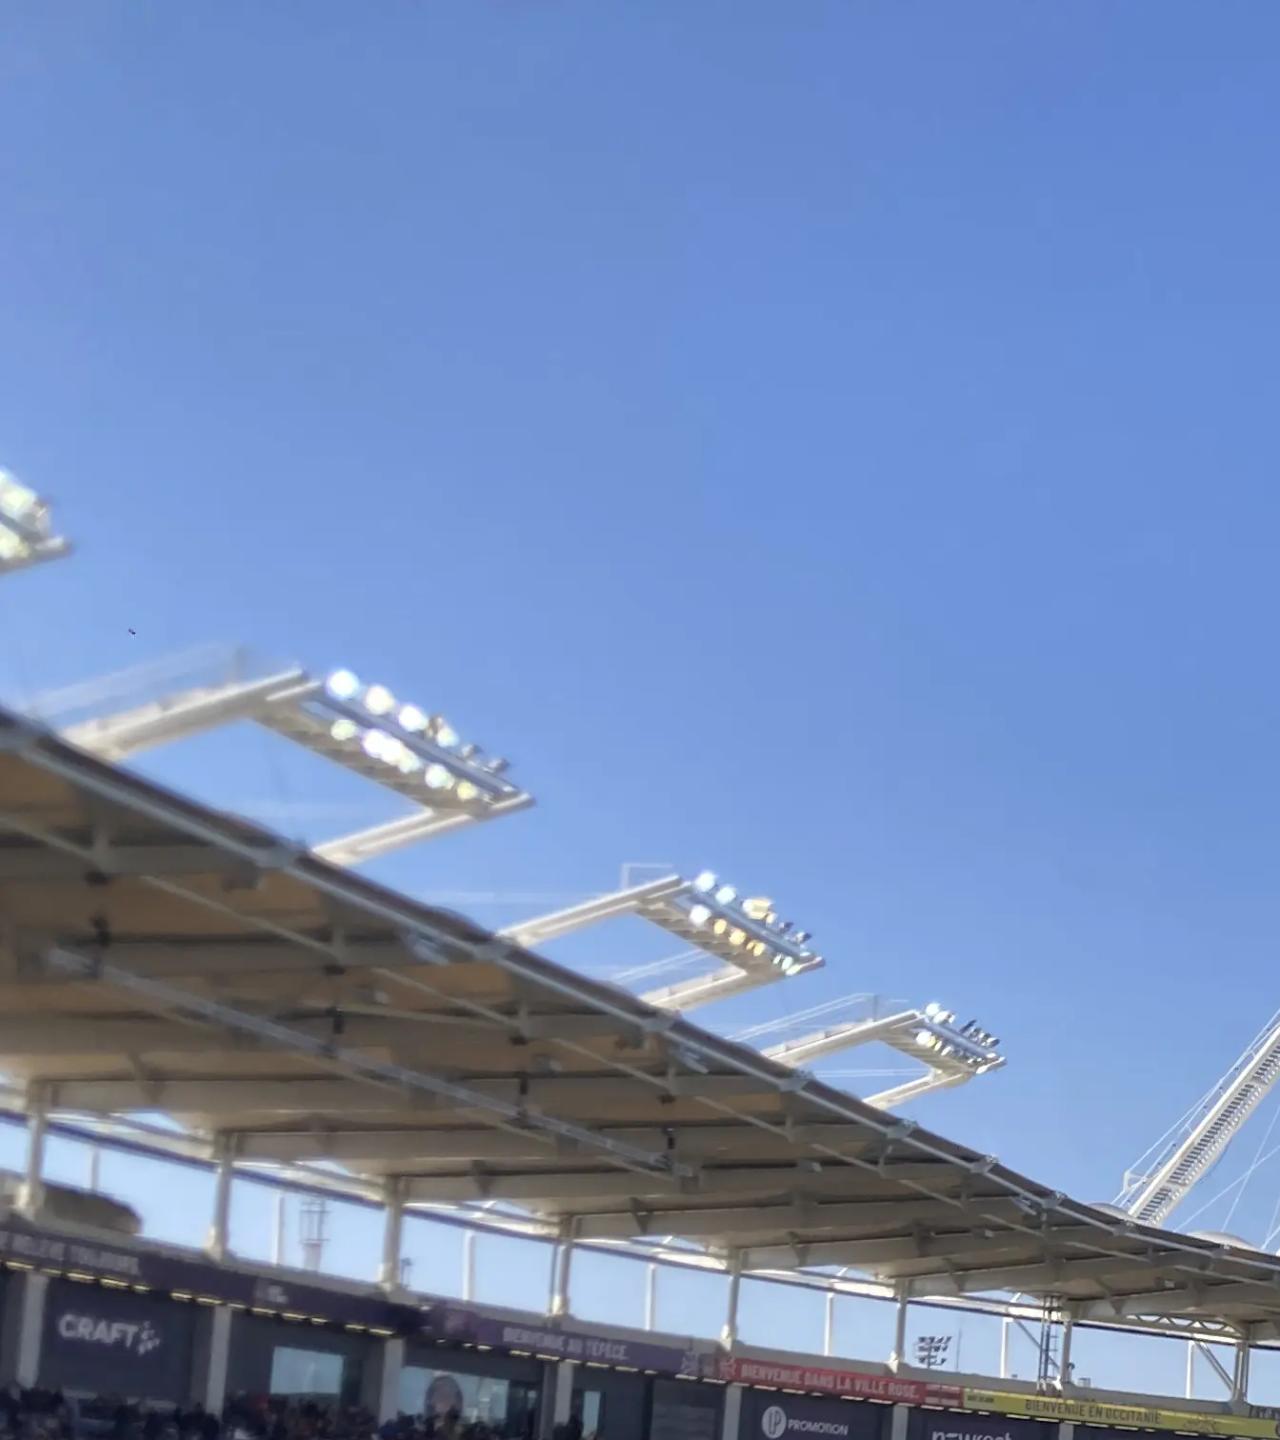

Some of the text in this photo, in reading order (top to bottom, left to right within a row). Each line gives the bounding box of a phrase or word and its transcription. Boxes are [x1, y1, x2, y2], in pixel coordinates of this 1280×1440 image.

[58, 1313, 141, 1348] CRAFT
[740, 1363, 802, 1385] BIENVENUE
[804, 1371, 835, 1390] DANS
[836, 1373, 851, 1390] LA
[854, 1377, 885, 1395] VILLE
[1025, 1399, 1162, 1425] BIENVENUE EN OCCITANIE
[787, 1418, 849, 1436] PROMOTION
